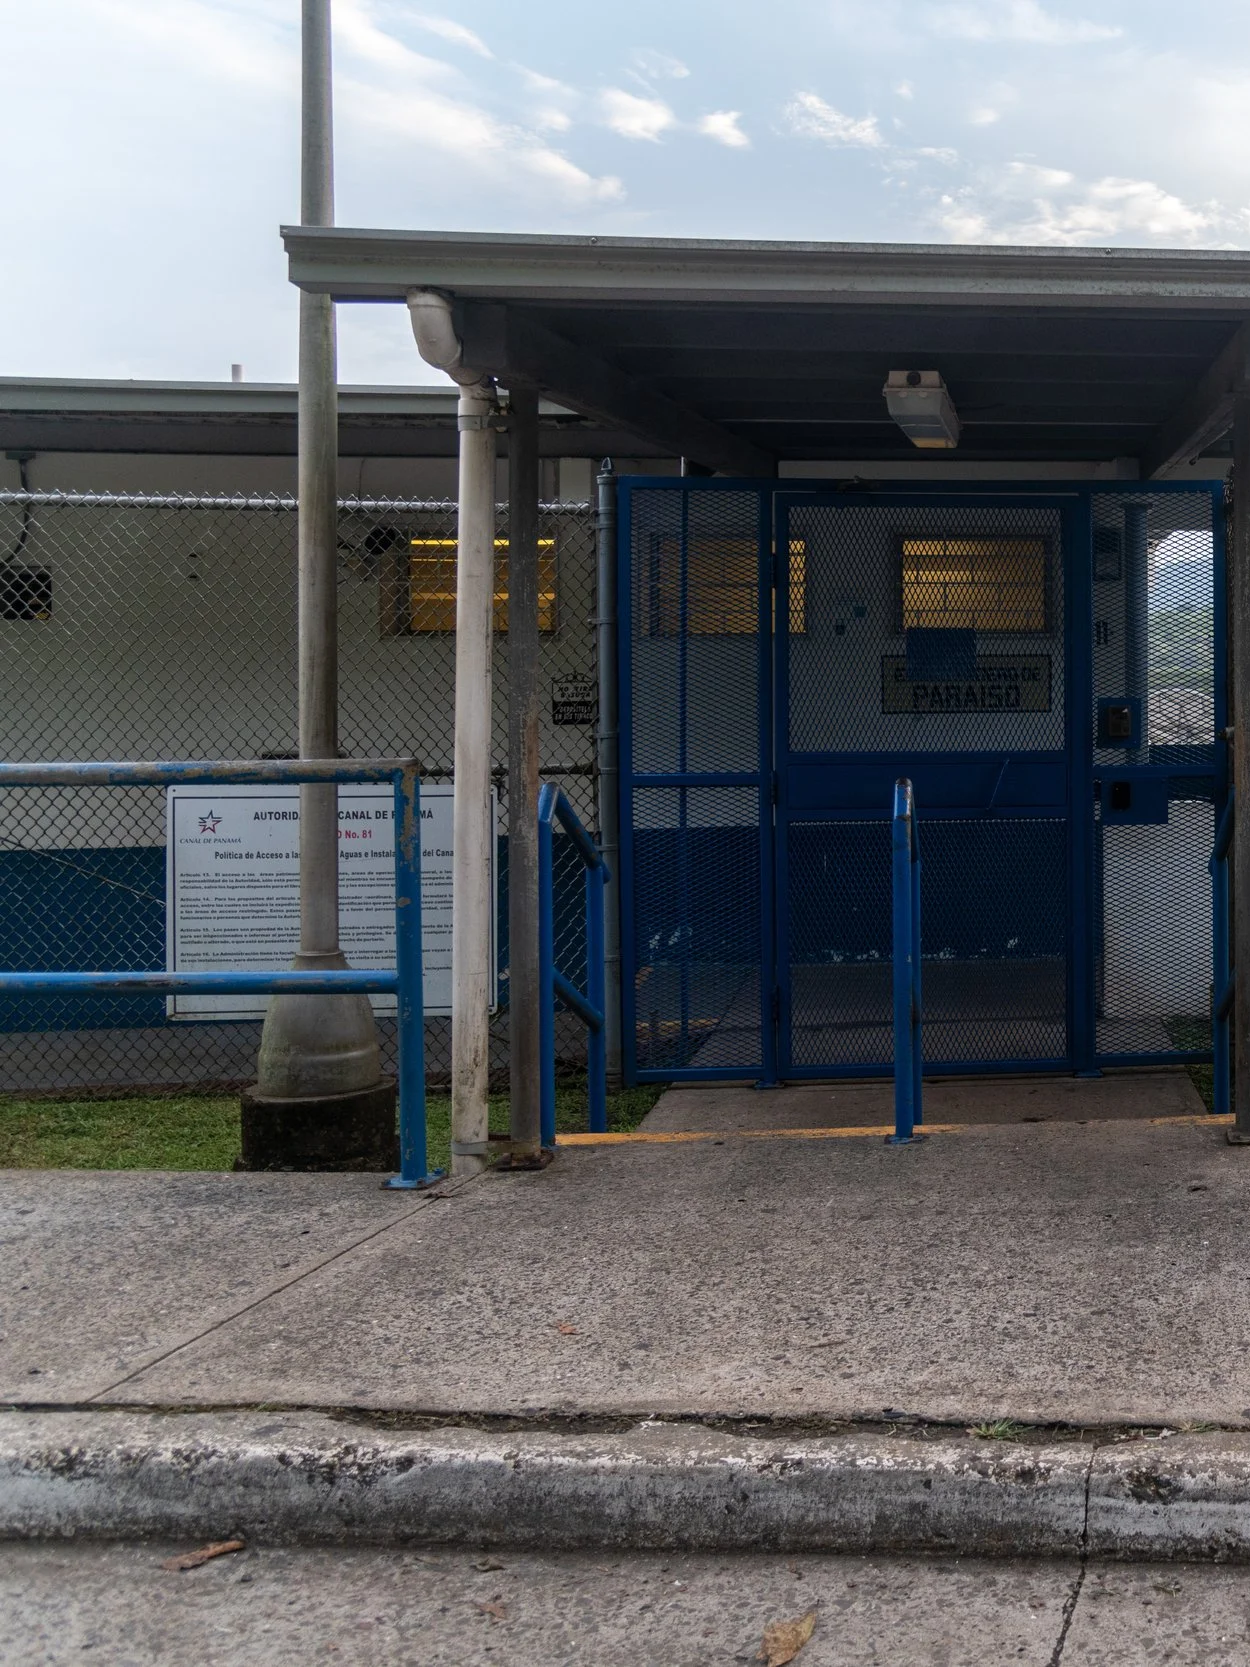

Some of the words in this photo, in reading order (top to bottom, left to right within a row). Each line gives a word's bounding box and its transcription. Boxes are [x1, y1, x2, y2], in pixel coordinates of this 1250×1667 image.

[912, 684, 1021, 709] PARAISO
[253, 811, 301, 821] AUTORID
[338, 810, 372, 820] CANAL
[375, 810, 388, 820] DE
[345, 830, 359, 839] No.
[362, 830, 373, 839] 81
[214, 851, 243, 860] Política
[245, 851, 254, 860] de
[256, 851, 283, 860] Acceso
[339, 851, 362, 860] Aguas
[422, 849, 434, 857] del
[435, 849, 454, 857] Cana
